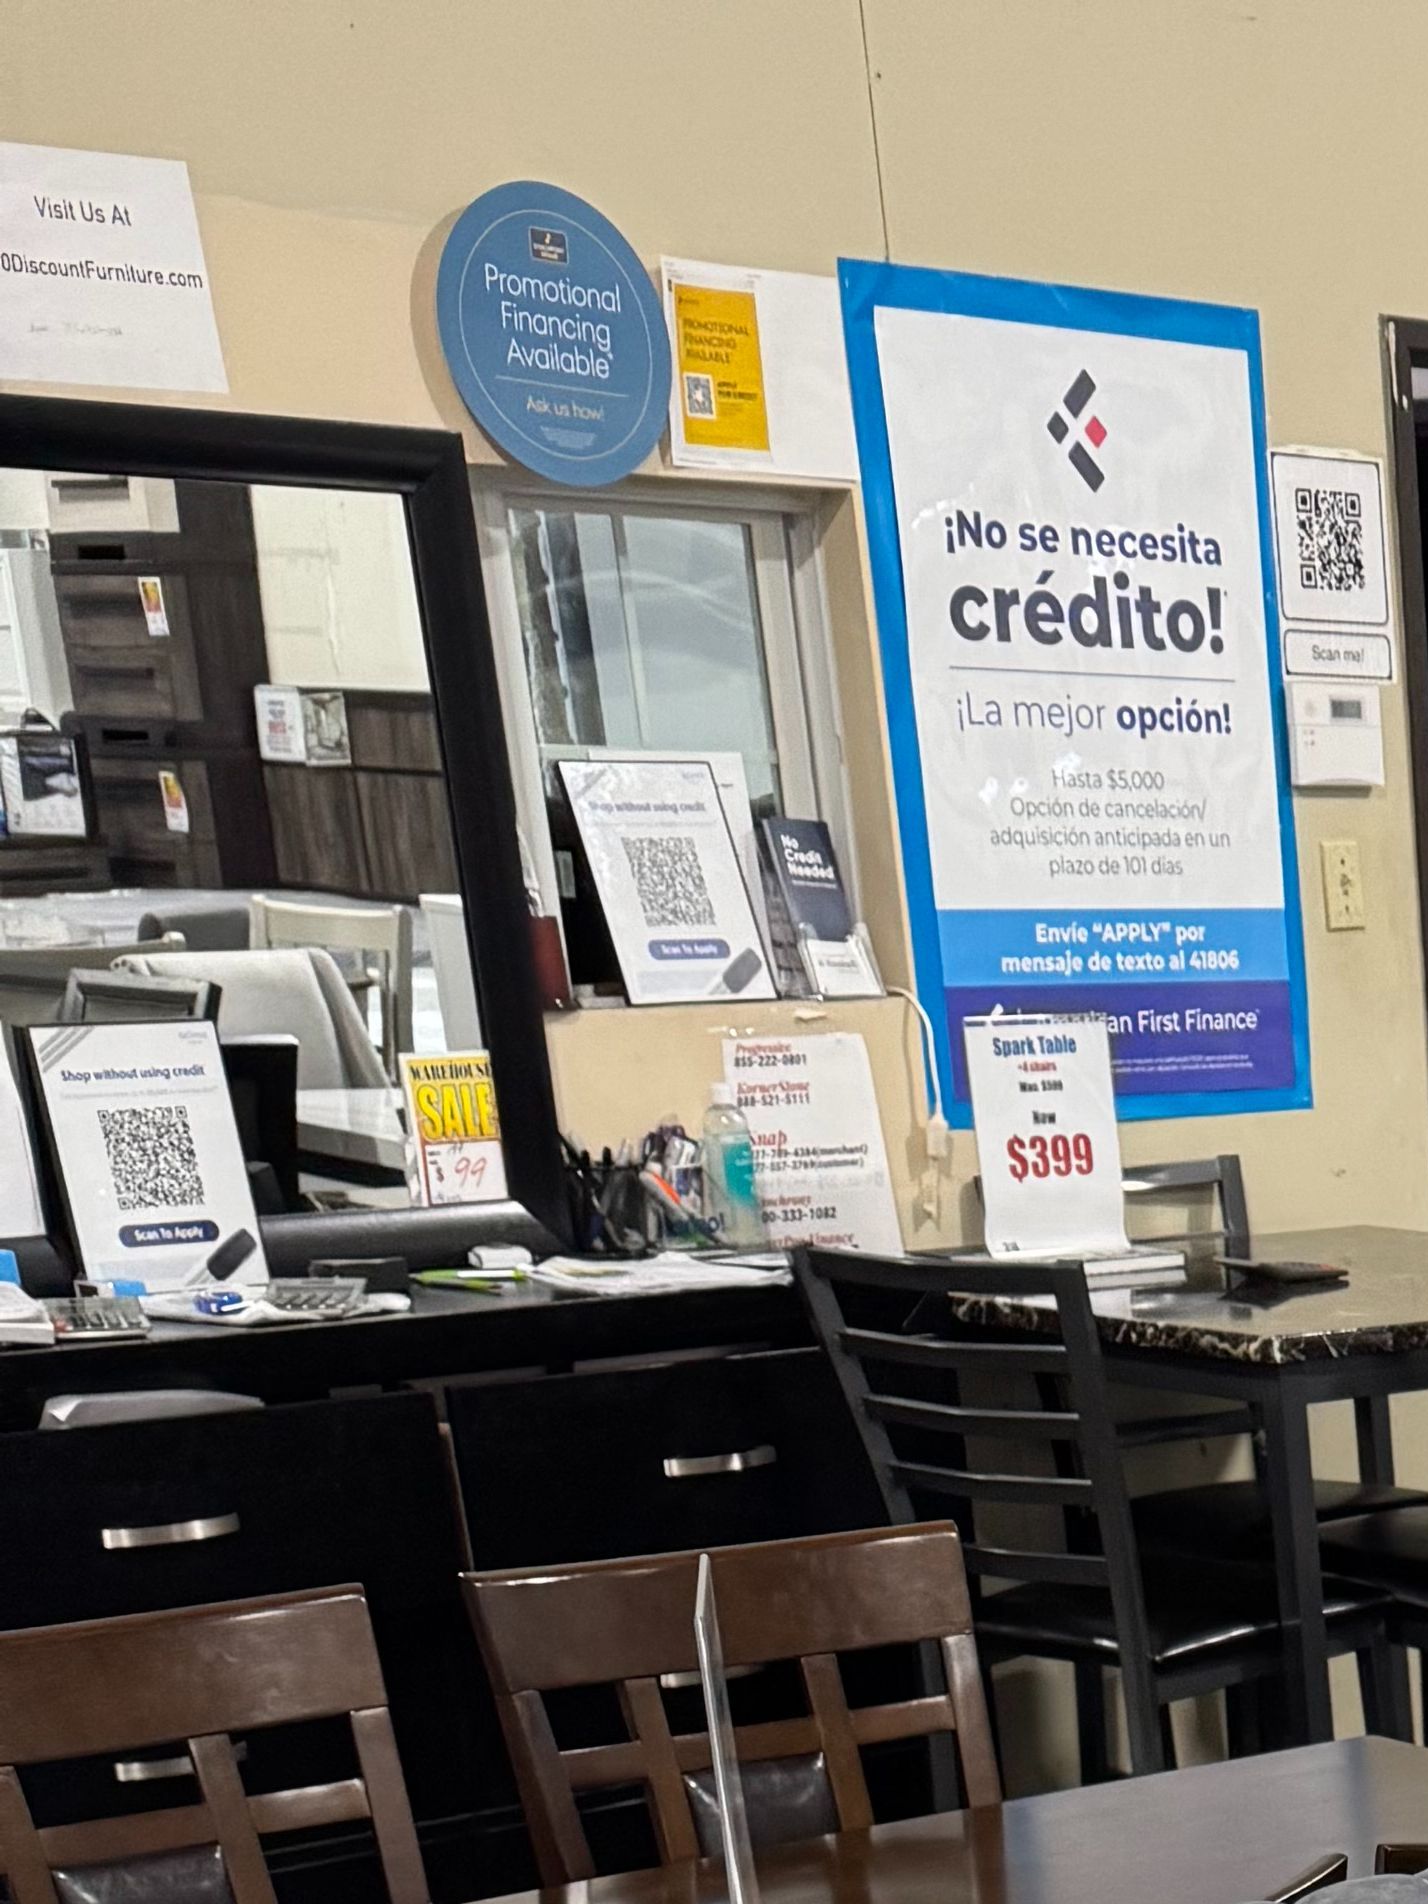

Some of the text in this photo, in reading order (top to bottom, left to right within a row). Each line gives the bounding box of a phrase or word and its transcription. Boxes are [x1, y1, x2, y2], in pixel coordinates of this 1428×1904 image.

[34, 195, 132, 227] Visit Us At
[484, 263, 621, 313] Promotional
[501, 301, 611, 352] Financing
[526, 395, 550, 414] Ask
[554, 400, 570, 416] us
[945, 509, 1222, 566] ¡No se necesita
[949, 570, 1224, 655] crédito!
[1312, 645, 1340, 661] Scan
[957, 691, 1231, 739] ¡La mejor opción!
[1052, 768, 1165, 792] Hasta $5,000
[1010, 796, 1208, 821] Opción de cancelación/
[780, 834, 799, 850] No
[990, 826, 1231, 850] adquisición anticipada en un
[784, 848, 824, 866] Credit
[1049, 855, 1095, 877] plazo
[1099, 856, 1120, 875] de
[1123, 856, 1148, 875] 101
[787, 862, 837, 880] Needed
[1175, 924, 1206, 946] por
[1001, 949, 1240, 977] mensaje de texto al 41806
[1137, 1010, 1182, 1033] First
[1185, 1008, 1258, 1032] Finance
[992, 1034, 1078, 1057] Spark Table
[93, 1067, 139, 1082] without
[139, 1066, 171, 1081] using
[173, 1065, 205, 1078] credit
[416, 1082, 497, 1142] SALE
[1006, 1133, 1094, 1184] $399
